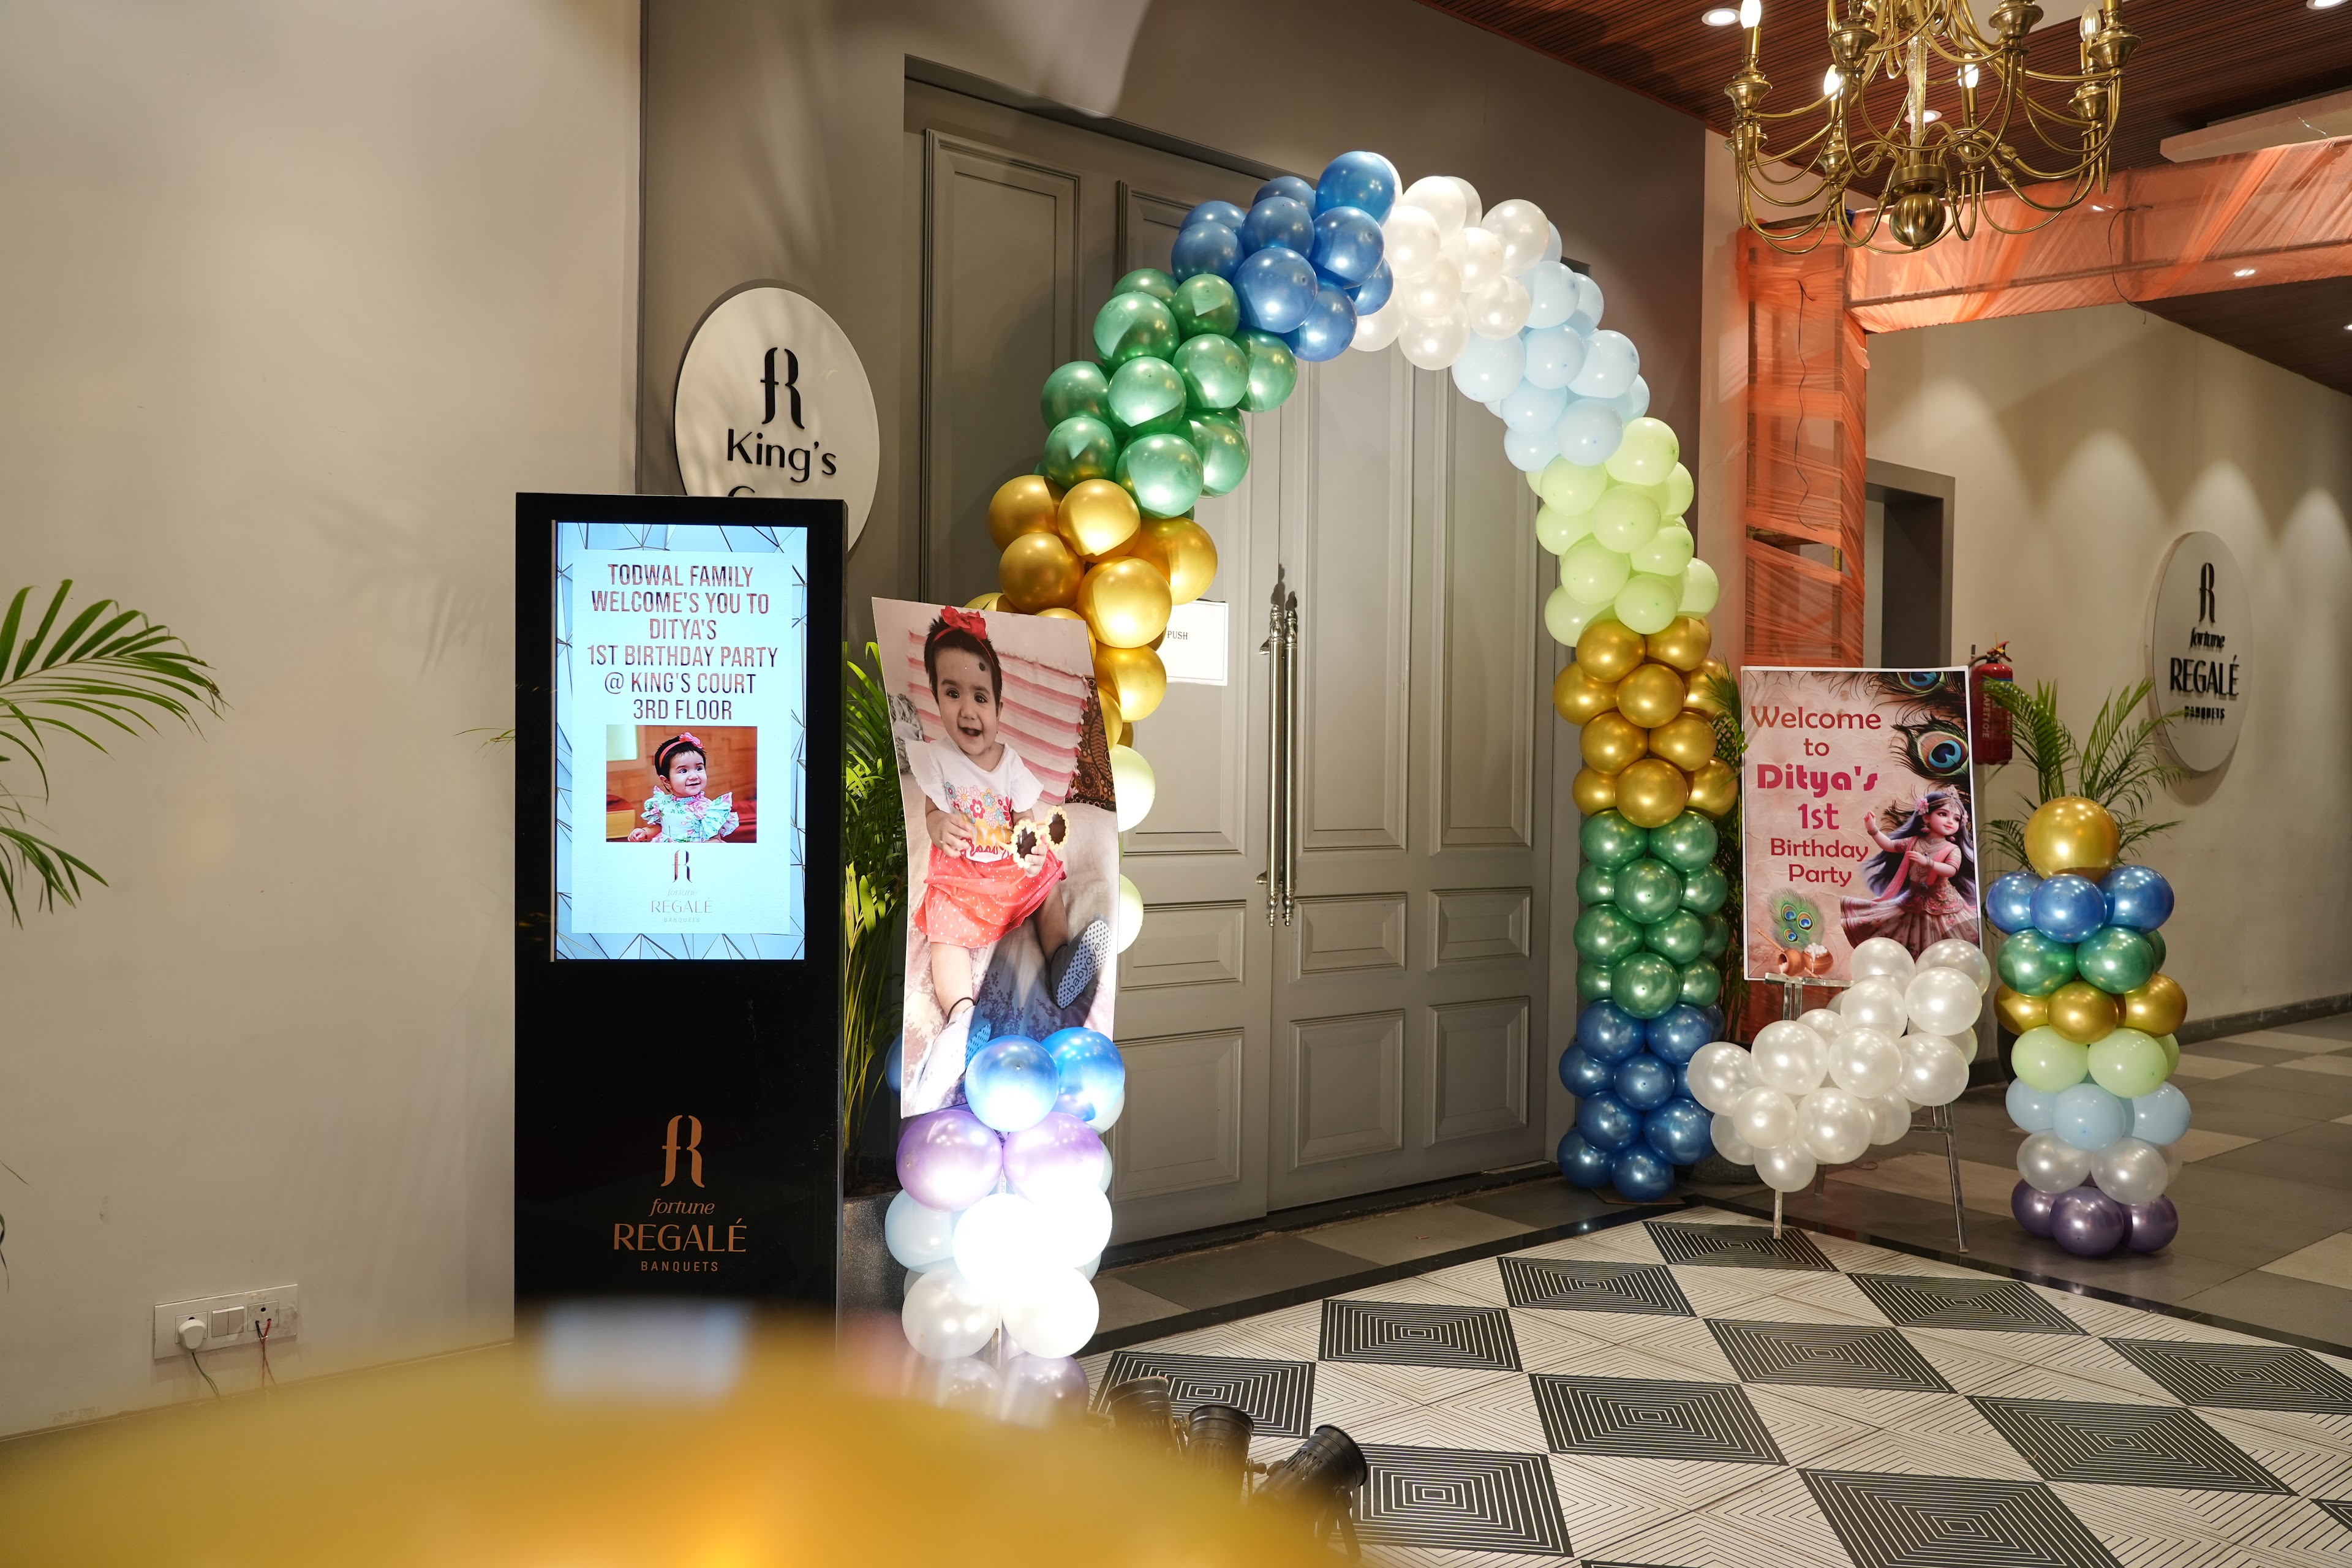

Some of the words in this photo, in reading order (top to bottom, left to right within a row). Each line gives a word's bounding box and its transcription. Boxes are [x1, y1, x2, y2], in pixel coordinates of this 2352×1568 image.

[727, 429, 837, 483] King's
[608, 564, 684, 586] TODWAL
[690, 565, 754, 587] FAMILY
[591, 590, 699, 613] WELCOME'S
[705, 592, 741, 614] YOU
[747, 594, 769, 614] TO
[649, 618, 717, 640] DITYA'S
[1167, 630, 1188, 640] PUSH
[2189, 627, 2225, 649] fortune
[587, 644, 618, 665] 1ST
[625, 645, 715, 667] BIRTHDAY
[720, 646, 778, 668] PARTY
[605, 671, 624, 695] @
[631, 672, 691, 693] KING'S
[698, 673, 757, 694] COURT
[2170, 655, 2239, 696] REGALÉ
[633, 699, 668, 720] 3RD
[676, 699, 733, 720] FLOOR
[1751, 705, 1882, 730] Welcome
[1803, 738, 1830, 756] to
[1757, 763, 1879, 797] Ditya's
[1798, 802, 1839, 830] 1st
[1770, 837, 1869, 862] Birthday
[1789, 864, 1852, 887] Party
[667, 888, 698, 897] fortune
[651, 897, 713, 913] REGALÉ
[1067, 943, 1101, 993] babyoye
[648, 1198, 715, 1217] fortune
[614, 1218, 747, 1253] REGALÉ
[641, 1261, 718, 1273] BANQUETS
